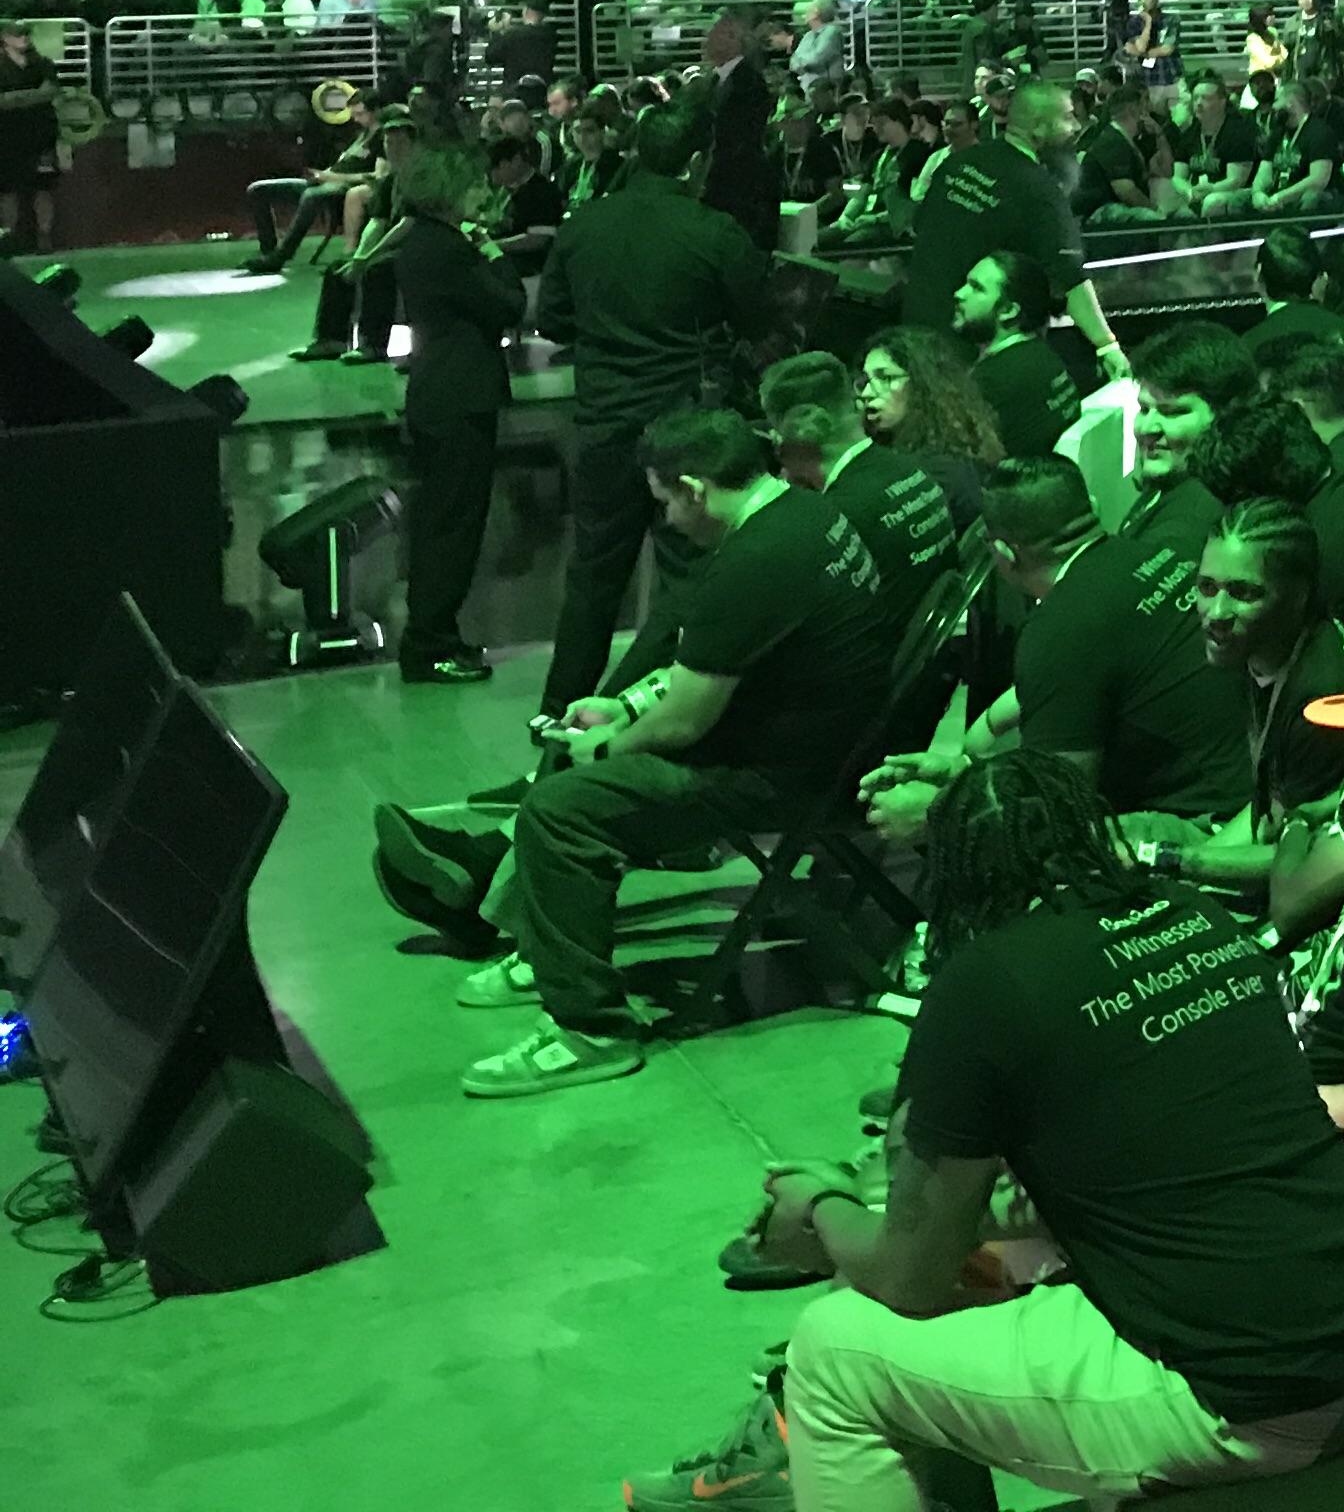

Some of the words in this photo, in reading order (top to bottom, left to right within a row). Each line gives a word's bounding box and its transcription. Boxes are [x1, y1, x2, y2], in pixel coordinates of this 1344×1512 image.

[1136, 590, 1166, 616] The
[1103, 947, 1118, 970] I
[1113, 911, 1212, 961] Witnessed
[1081, 990, 1134, 1027] The
[1132, 960, 1192, 1000] Most
[1141, 988, 1229, 1042] Console
[1227, 974, 1266, 1001] Ever
